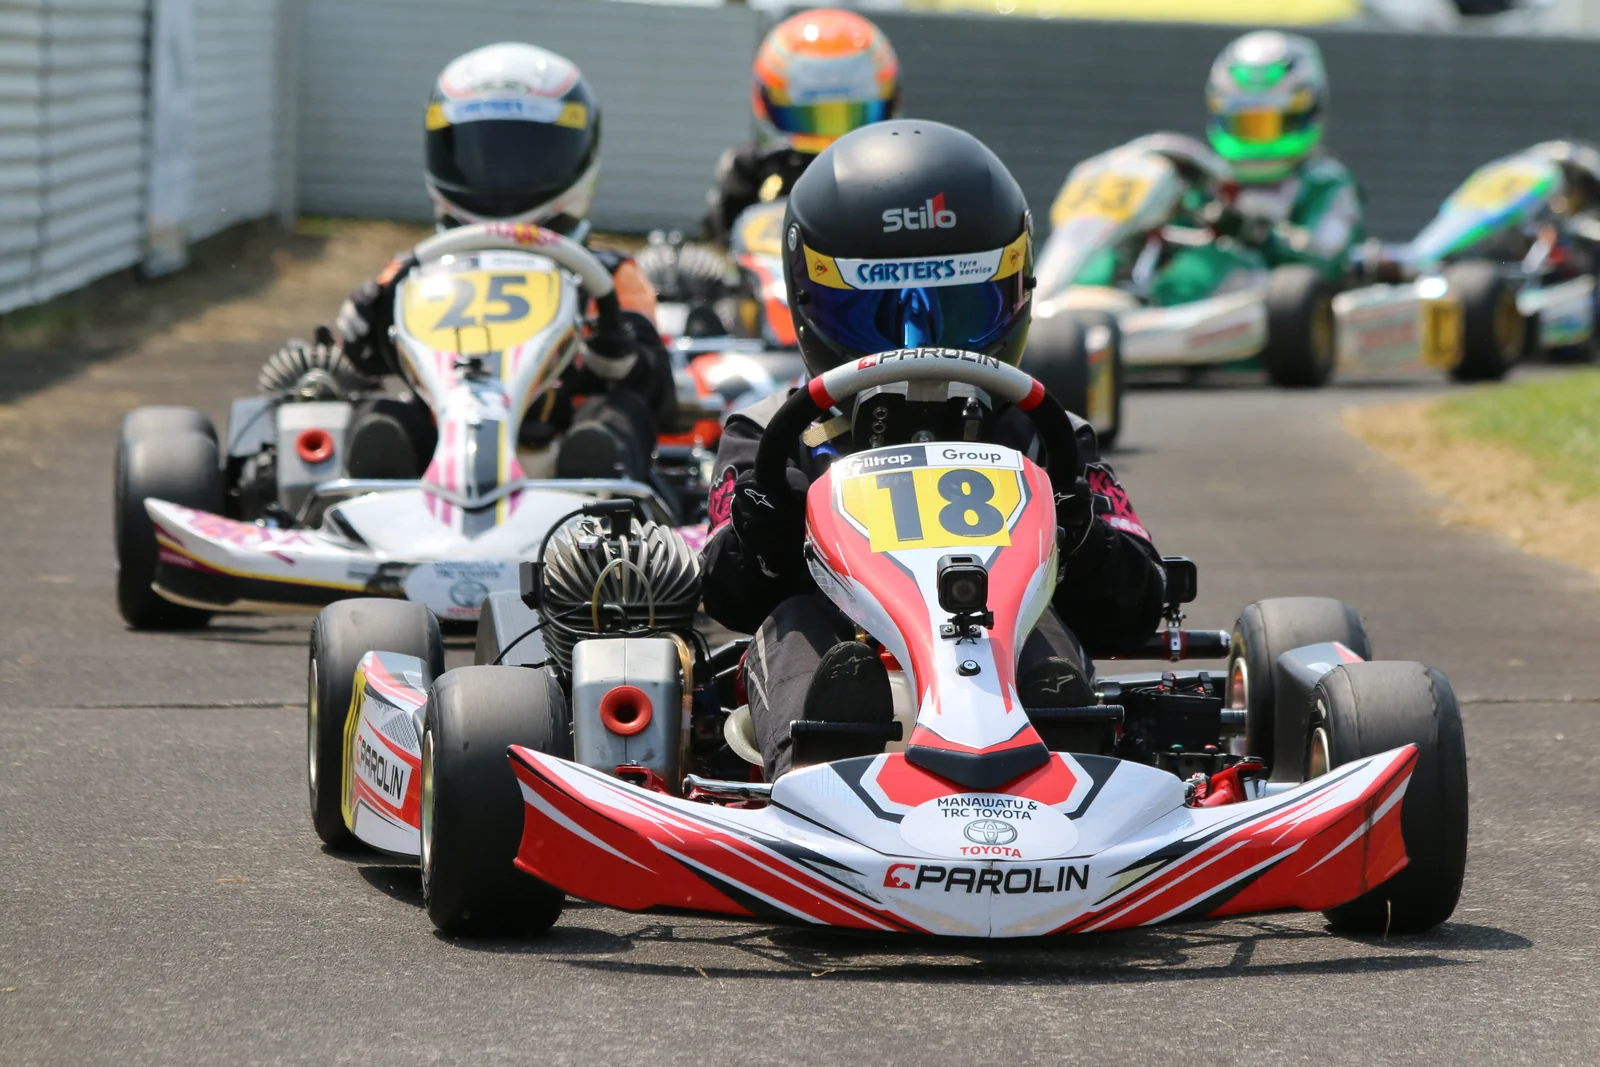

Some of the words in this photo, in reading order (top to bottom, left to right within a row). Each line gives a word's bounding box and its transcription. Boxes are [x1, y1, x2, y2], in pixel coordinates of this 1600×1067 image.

[882, 193, 956, 232] Stilo
[858, 259, 956, 285] CARTER'S
[960, 260, 977, 270] tyre
[960, 267, 993, 276] service
[430, 275, 531, 329] 25
[943, 449, 1002, 463] Group
[876, 469, 1004, 541] 18
[360, 740, 404, 800] PAROLIN
[937, 797, 1024, 809] MANAWATU
[1028, 801, 1037, 810] &
[942, 808, 970, 818] TRC
[976, 808, 1032, 820] TOYOTA
[960, 846, 1022, 858] TOYOTA
[915, 864, 1089, 894] PAROLIN
